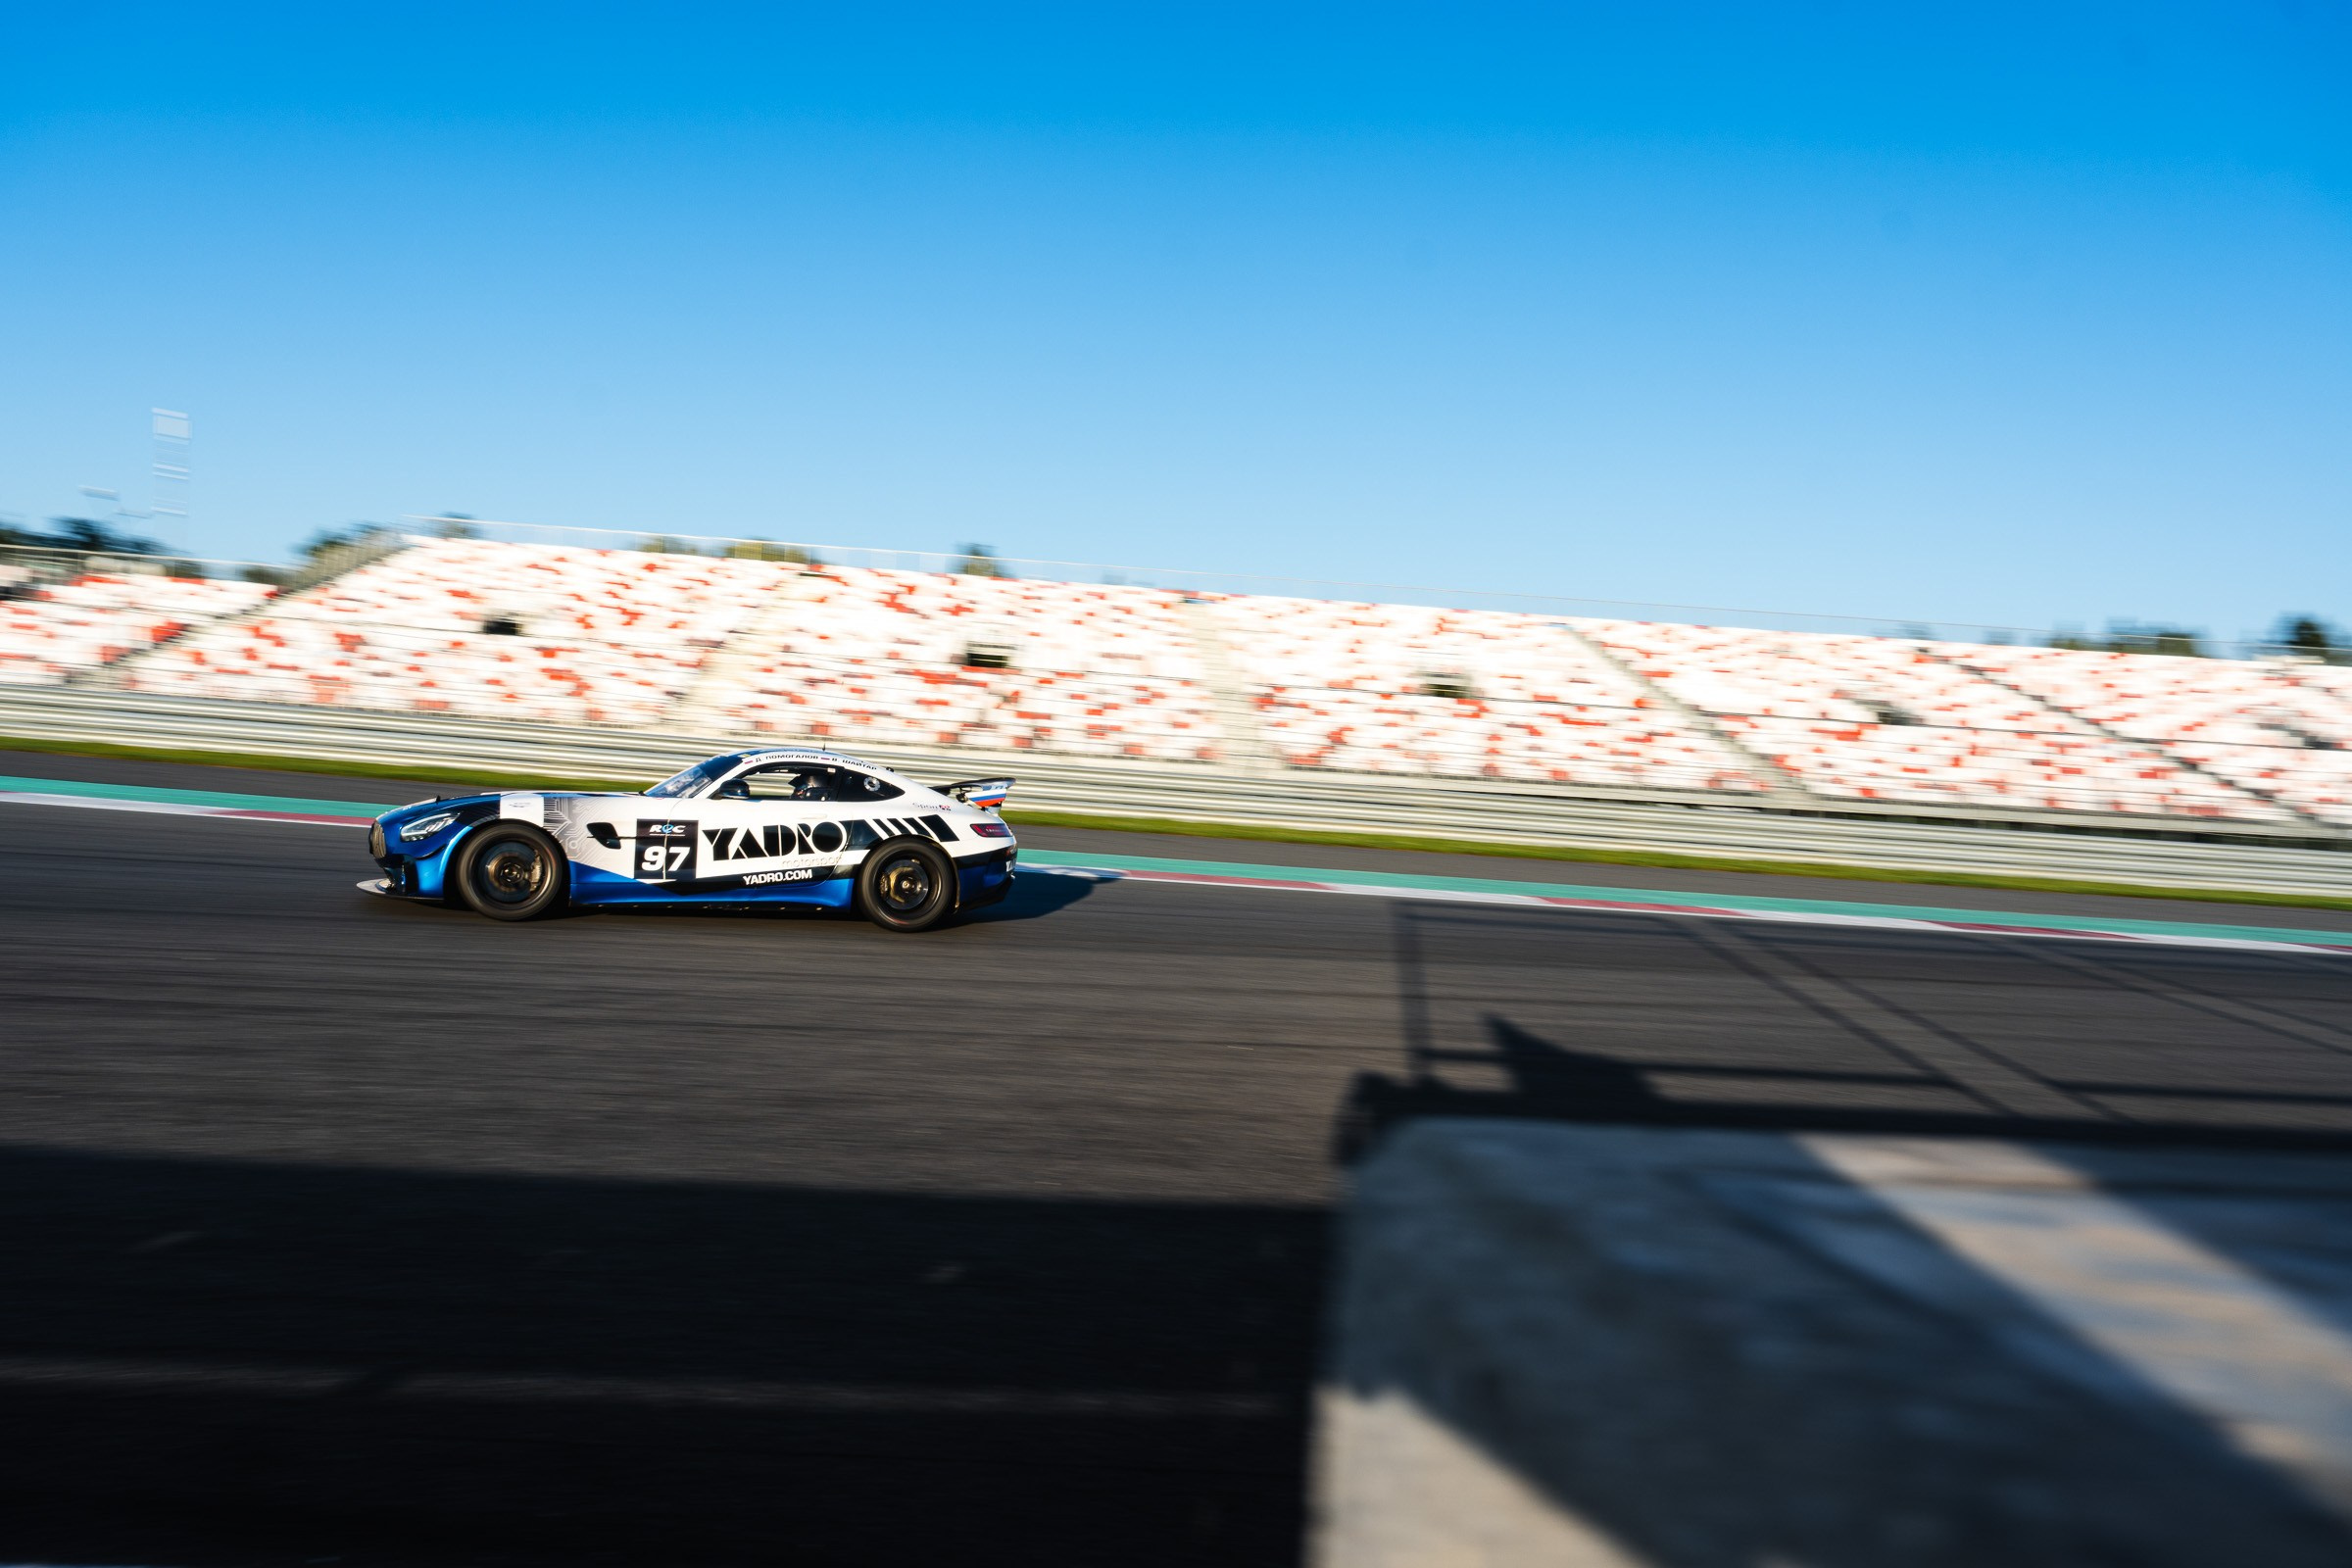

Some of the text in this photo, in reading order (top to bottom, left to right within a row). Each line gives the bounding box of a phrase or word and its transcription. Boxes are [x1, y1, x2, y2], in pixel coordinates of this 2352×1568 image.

[702, 821, 847, 861] YADRO
[641, 845, 691, 872] 97
[742, 868, 812, 886] YADRO.COM
